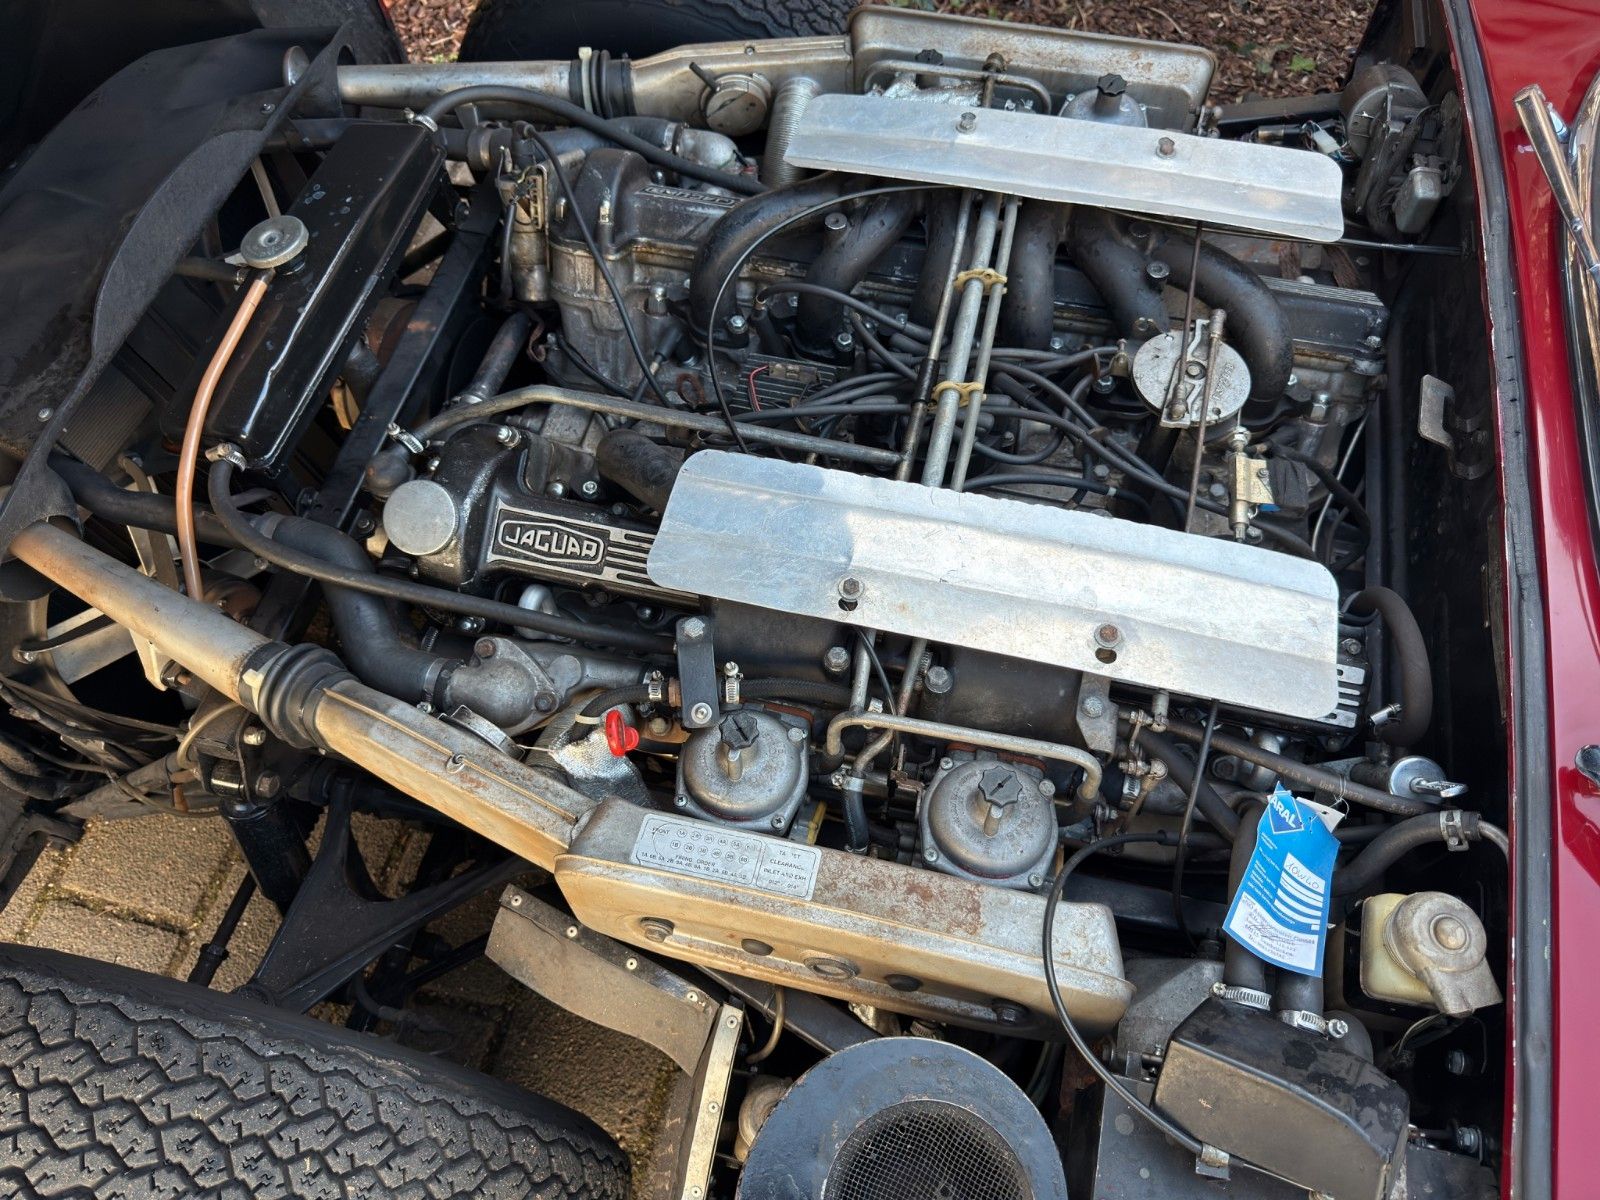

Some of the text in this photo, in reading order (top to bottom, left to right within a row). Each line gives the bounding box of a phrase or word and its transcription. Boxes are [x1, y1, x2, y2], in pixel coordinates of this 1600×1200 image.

[505, 527, 598, 558] JAGUAR
[1269, 795, 1296, 828] ARAL
[696, 858, 716, 867] ORDER
